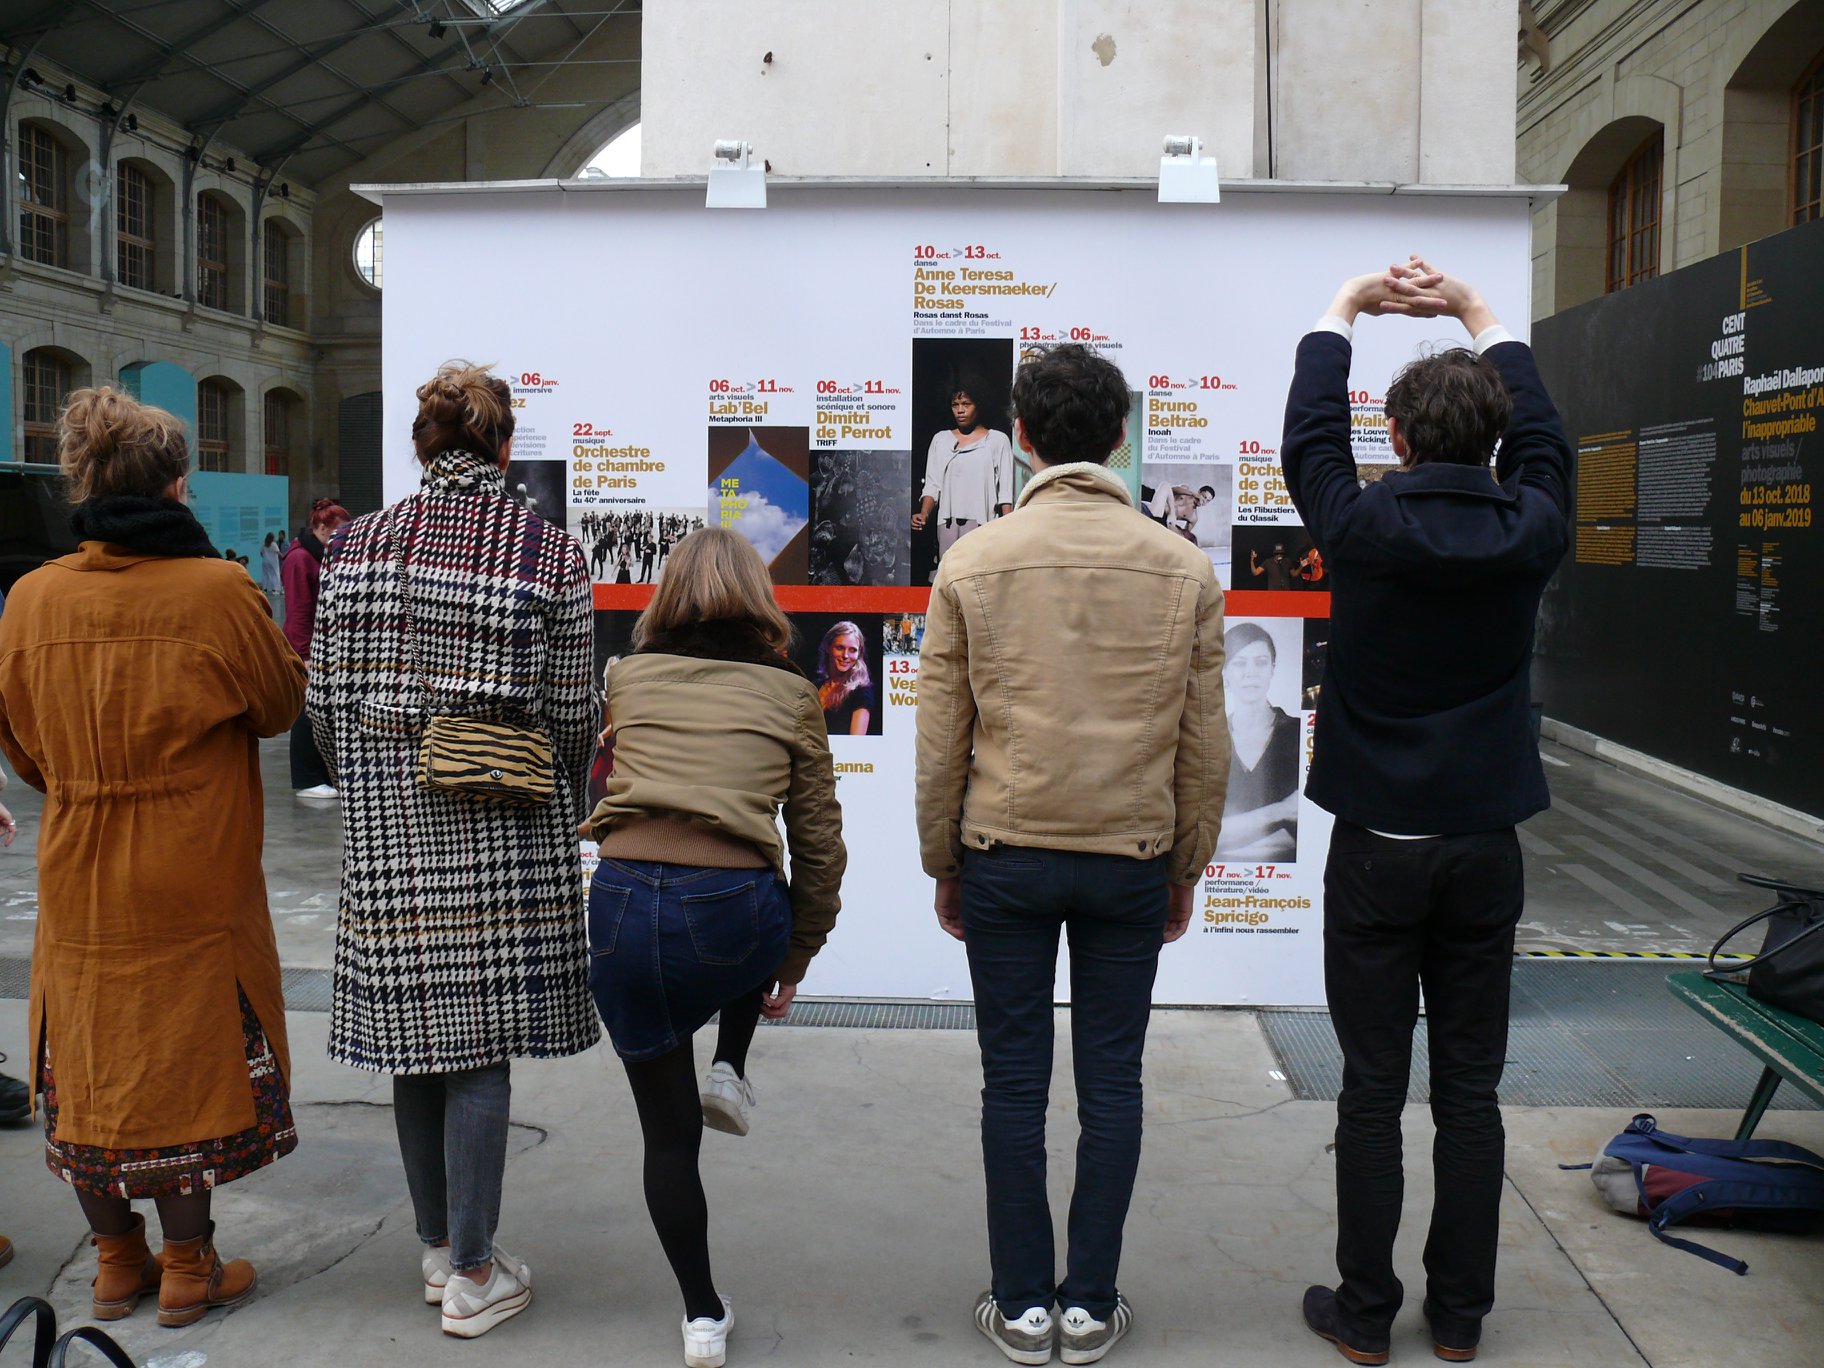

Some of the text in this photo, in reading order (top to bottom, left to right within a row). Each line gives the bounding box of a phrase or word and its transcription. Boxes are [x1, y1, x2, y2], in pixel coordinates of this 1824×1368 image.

[914, 245, 1001, 259] 10 oct. 13 oct.
[914, 268, 1014, 281] Anne Teresa
[914, 282, 936, 295] De
[914, 296, 964, 309] Rosas
[914, 311, 989, 319] Rosas danst Rosas
[914, 319, 1012, 327] Dans le cadre du Festival
[1722, 312, 1745, 335] CENT
[914, 327, 985, 335] d'Automne à Paris
[1019, 327, 1110, 343] 13 oct. 06 janv.
[1094, 341, 1123, 349] visuels
[1711, 334, 1745, 359] QUATRE
[521, 373, 541, 386] 06
[541, 379, 560, 387] janv.
[709, 380, 729, 393] 06
[757, 379, 777, 393] 11
[1149, 375, 1169, 389] 06
[1200, 376, 1221, 389] 10
[1743, 366, 1824, 397] Raphaël Dallapor
[816, 380, 837, 394] 06
[864, 381, 884, 394] 11
[1149, 389, 1172, 397] danse
[727, 393, 755, 401] visuels
[816, 394, 863, 402] installation
[1349, 390, 1369, 404] 10
[1743, 386, 1824, 417] Chauvet-Pont d'A
[709, 401, 768, 415] Lab'Bel
[816, 403, 854, 412] scénique
[856, 403, 865, 411] et
[1149, 399, 1198, 412] Bruno
[709, 415, 763, 424] Metaphoria III
[816, 411, 870, 425] Dimitri
[1149, 413, 1208, 428] Beltrão
[573, 423, 613, 437] 22 sept.
[816, 425, 892, 439] de Perrot
[573, 437, 606, 446] musique
[816, 439, 837, 447] TRIFF
[1357, 436, 1387, 444] Kicking
[573, 444, 650, 458] Orchestre
[1148, 444, 1191, 452] du Festival
[1239, 440, 1277, 455] 10 nov.
[1761, 438, 1795, 459] visuels
[1200, 453, 1220, 461] Paris
[1239, 455, 1273, 463] musique
[573, 459, 665, 472] de chambre
[1239, 463, 1284, 477] Orche
[1741, 461, 1803, 487] photographie
[573, 475, 637, 488] de Paris
[721, 478, 739, 488] ME
[1239, 478, 1259, 491] de
[573, 496, 582, 504] du
[599, 496, 646, 504] anniversaire
[721, 489, 737, 498] TA
[1239, 492, 1293, 505] de Par
[1740, 484, 1811, 504] du 13 oct. 2018
[721, 510, 743, 519] RIA
[1238, 506, 1295, 514] Les Flibustiers
[1238, 514, 1279, 522] du Qlassik
[1739, 511, 1751, 527] au
[1751, 508, 1764, 527] 06
[889, 660, 910, 673] 13
[1205, 865, 1225, 878] 07
[1255, 865, 1275, 879] 17
[1204, 879, 1254, 887] performance
[1204, 895, 1311, 912] Jean-François
[1204, 910, 1269, 926] Spricigo
[1203, 926, 1208, 934] à
[1210, 926, 1234, 934] l'infini
